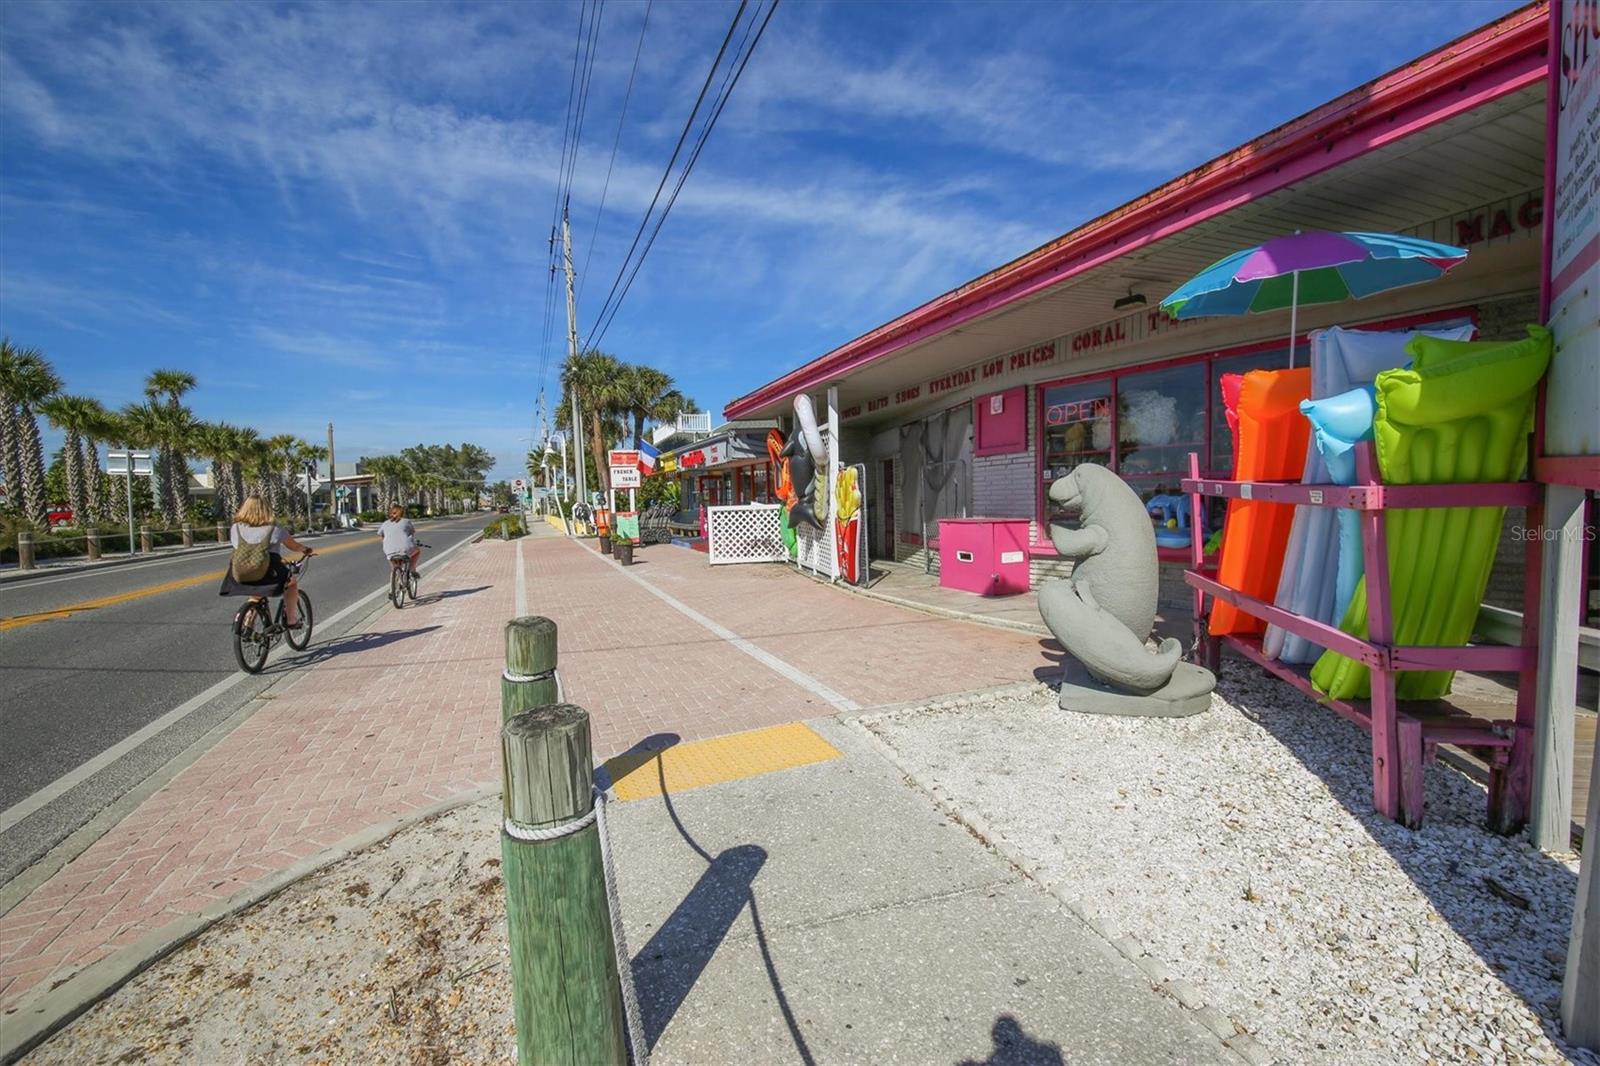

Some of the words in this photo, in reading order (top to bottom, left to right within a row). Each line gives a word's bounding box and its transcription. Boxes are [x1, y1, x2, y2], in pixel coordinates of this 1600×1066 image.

[1072, 323, 1126, 352] CORAL
[929, 368, 977, 394] EVERYDAY
[983, 361, 1004, 379] LOW
[1010, 343, 1056, 371] PRICES
[1047, 397, 1109, 425] OPEN
